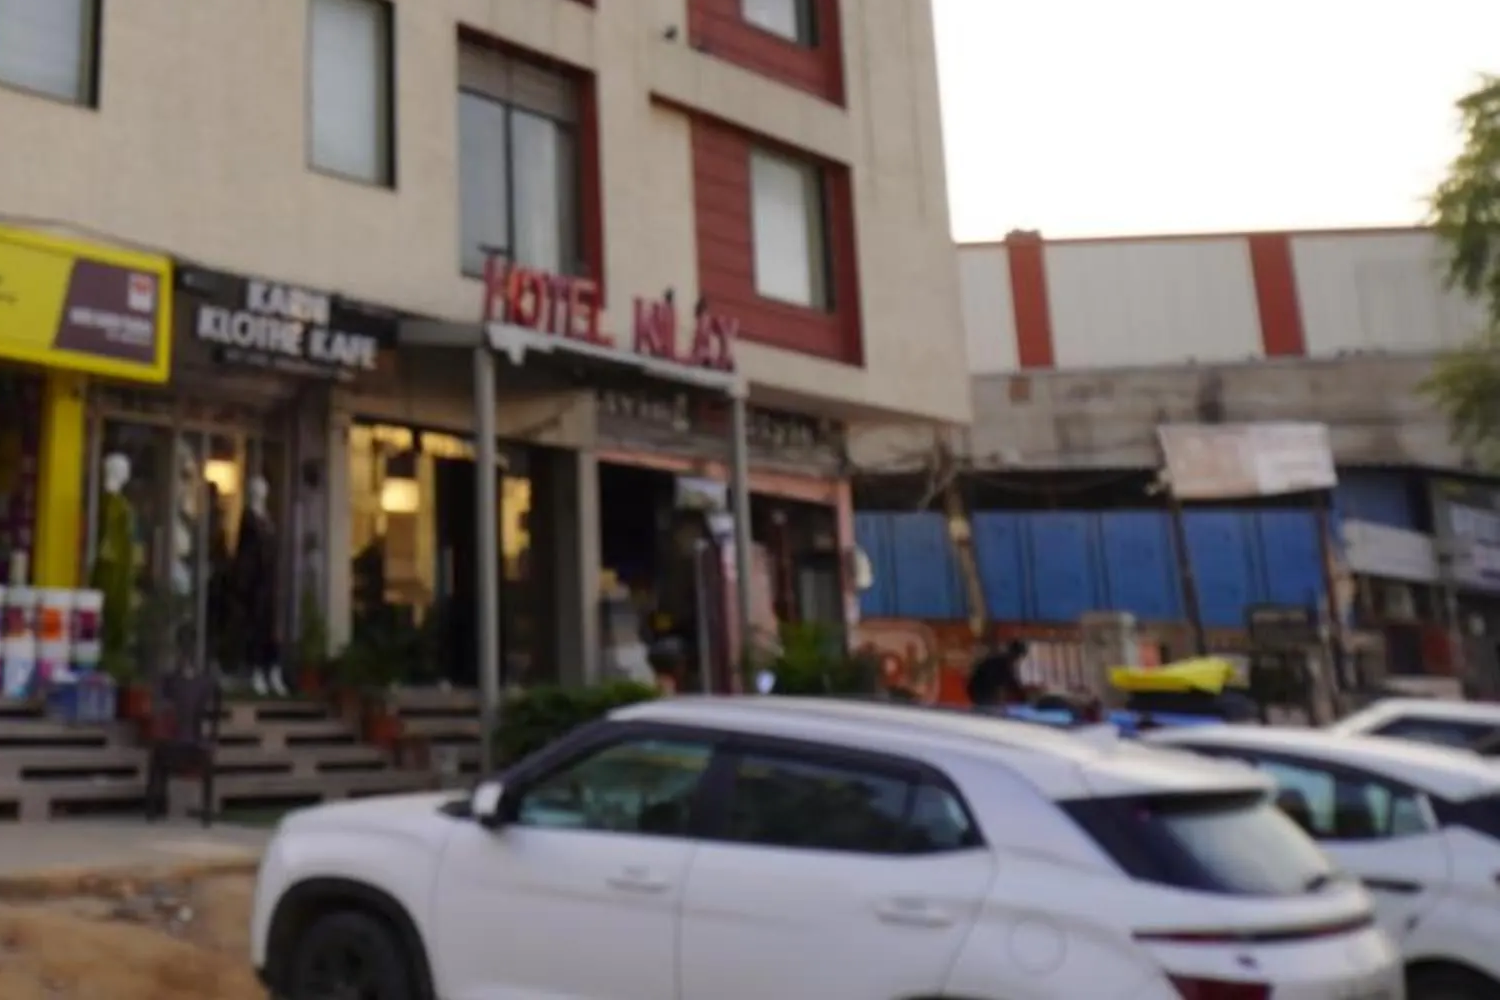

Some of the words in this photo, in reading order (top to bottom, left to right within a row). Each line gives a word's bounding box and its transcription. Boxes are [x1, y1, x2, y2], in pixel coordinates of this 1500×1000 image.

[197, 303, 304, 355] KLOTHE
[484, 253, 615, 347] HOTEL
[633, 295, 739, 373] NILAX
